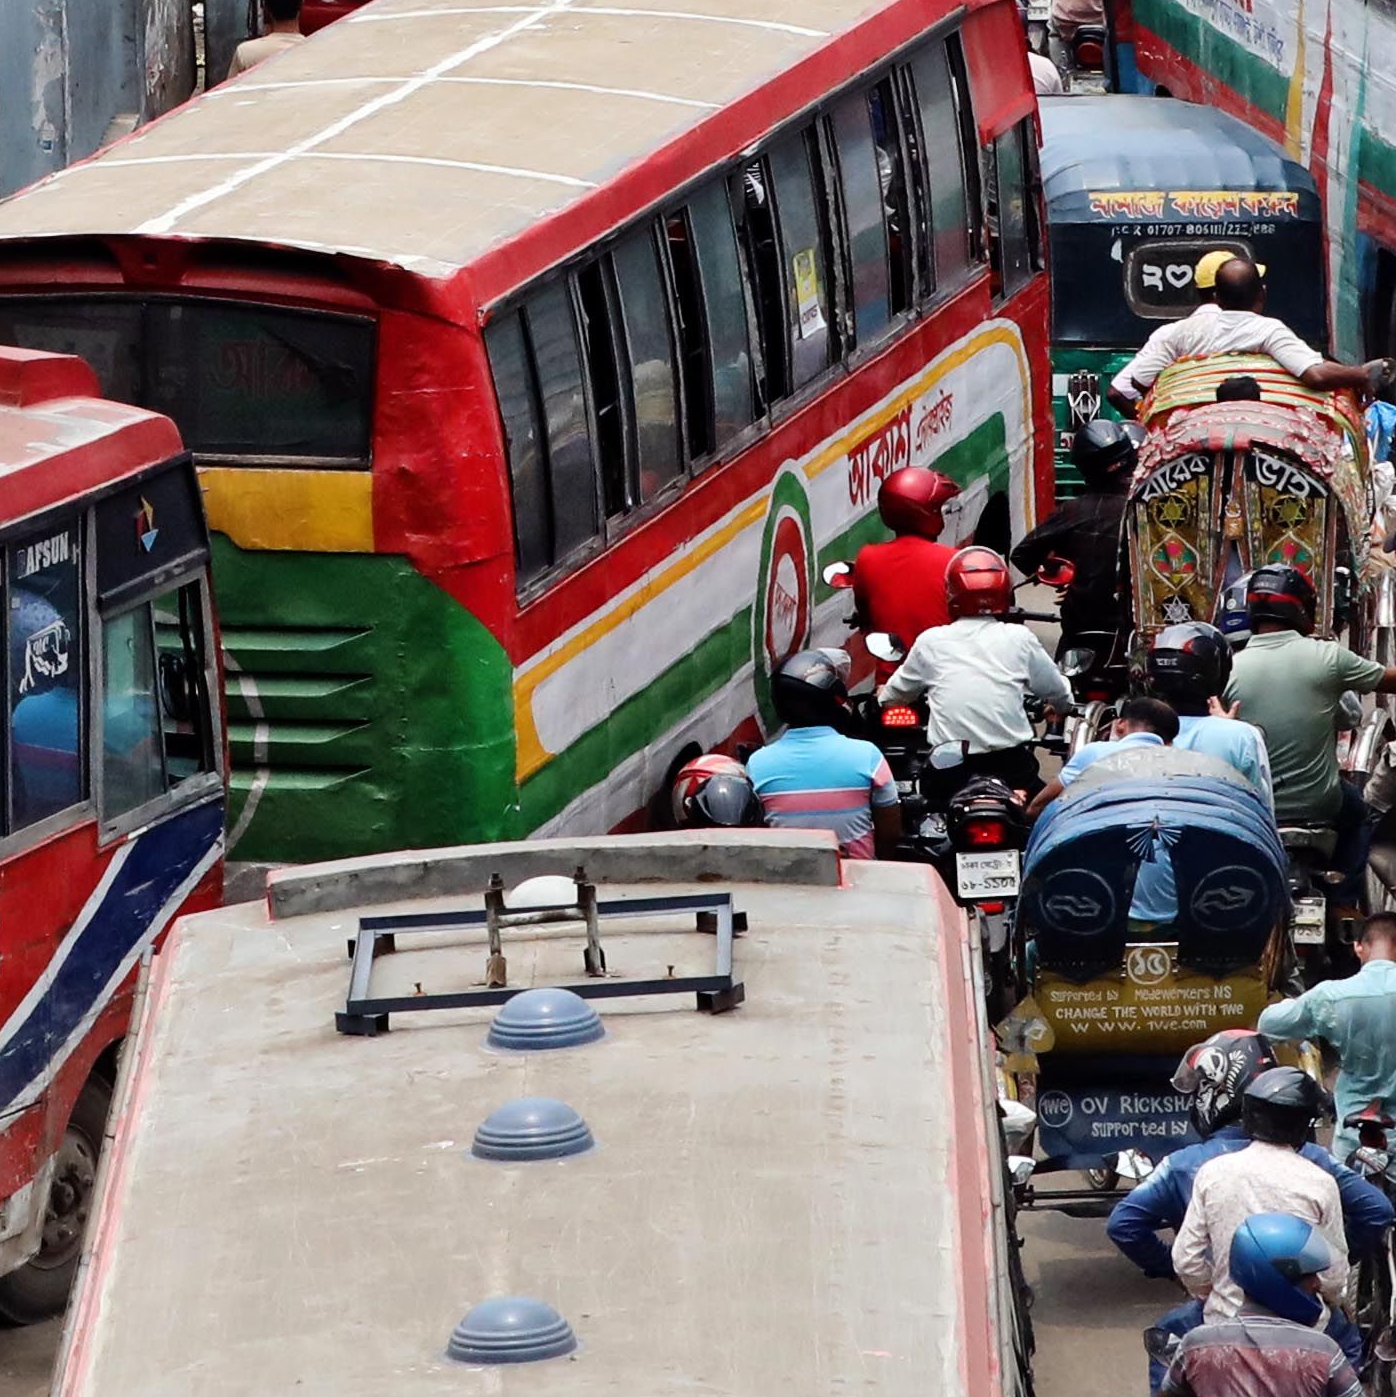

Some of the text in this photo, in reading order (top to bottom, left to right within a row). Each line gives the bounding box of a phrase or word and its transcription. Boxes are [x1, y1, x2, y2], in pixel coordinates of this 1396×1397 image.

[1088, 190, 1299, 220] নামাজ কায়েম করুন
[1213, 985, 1232, 1000] NS
[1055, 1006, 1108, 1019] CHANGE
[1112, 1006, 1137, 1019] THE
[1140, 1005, 1182, 1018] WORLD
[1081, 1096, 1109, 1113] OV
[1169, 1121, 1188, 1138] by
